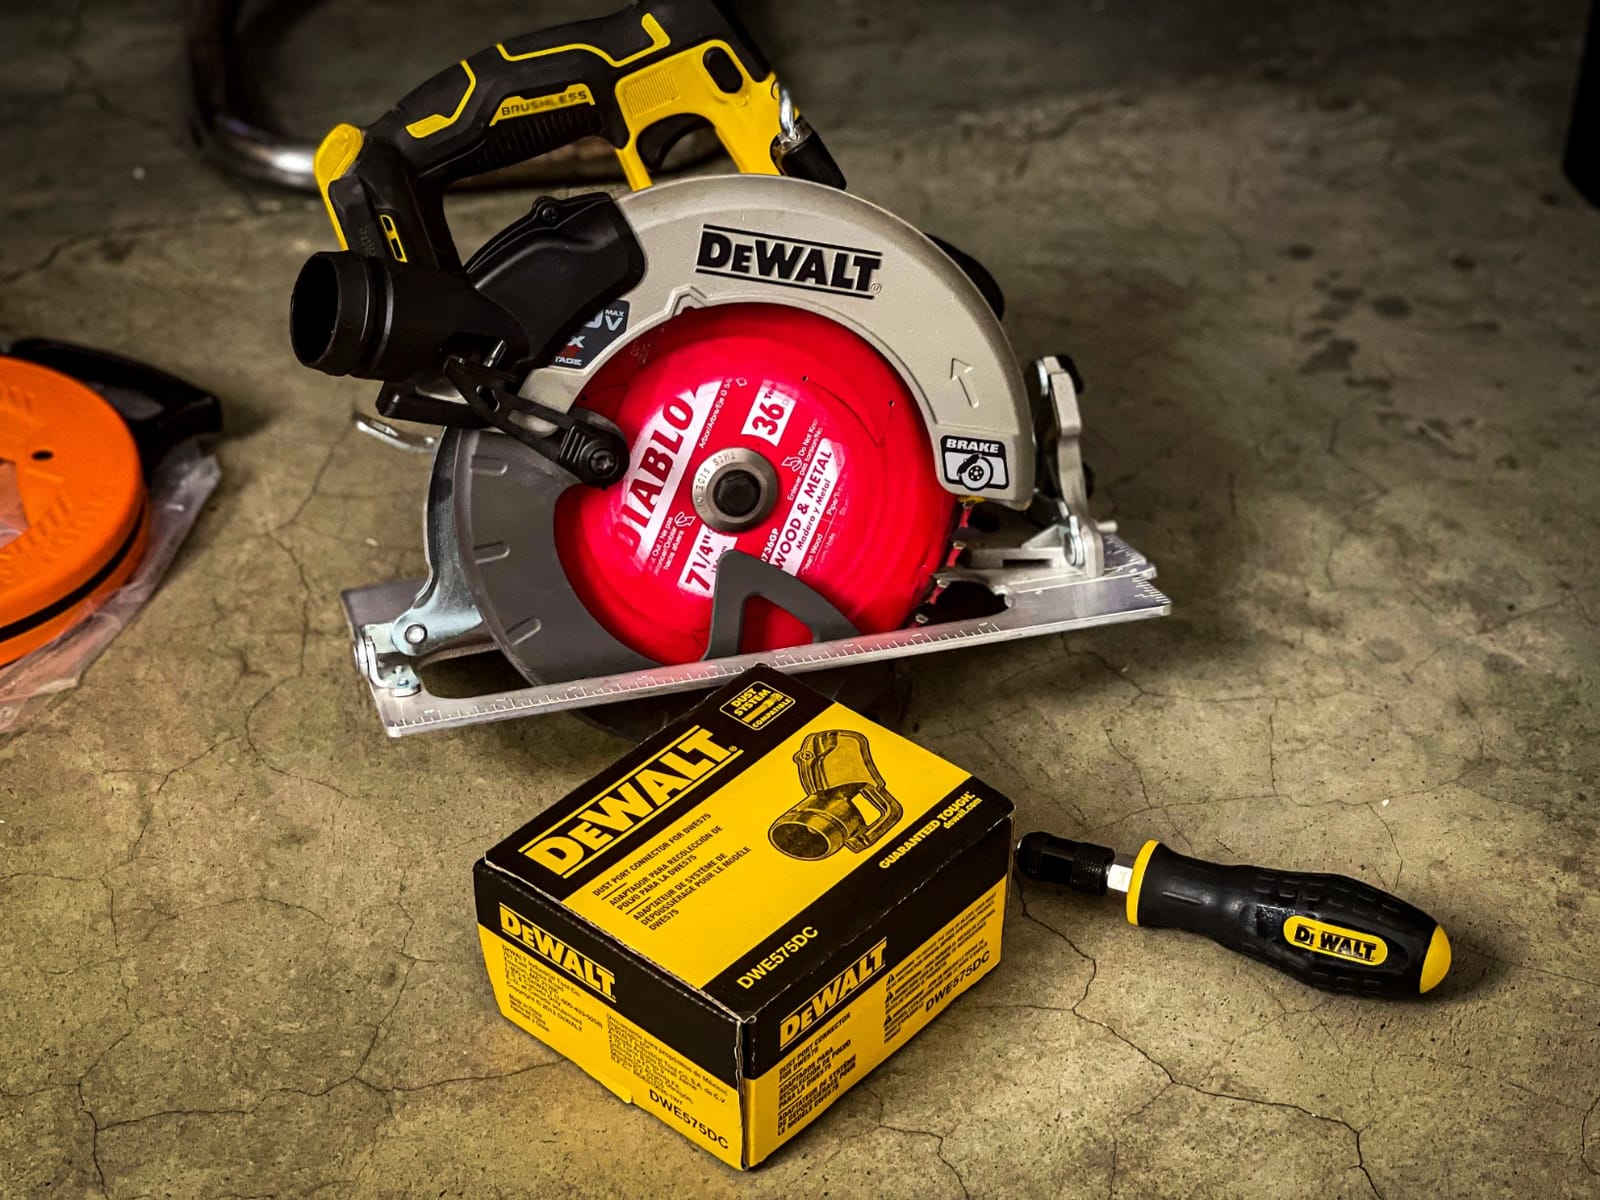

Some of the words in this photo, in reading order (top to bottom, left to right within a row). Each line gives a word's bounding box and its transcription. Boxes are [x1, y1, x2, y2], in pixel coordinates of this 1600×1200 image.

[605, 309, 624, 317] MAX
[752, 397, 785, 436] 36
[798, 446, 807, 457] Do
[803, 434, 812, 446] Not
[946, 438, 1000, 453] BRAKE
[614, 394, 695, 551] DIABLO
[771, 518, 801, 570] WOOD
[797, 502, 810, 515] &
[804, 452, 832, 499] METAL
[796, 515, 816, 551] Madera
[811, 506, 819, 514] y
[816, 479, 831, 505] Metal
[685, 568, 711, 591] 7
[731, 688, 757, 707] DUST
[734, 689, 771, 716] SYSTEM
[752, 699, 792, 728] COMPATIBLE
[592, 881, 613, 896] DUST
[611, 869, 631, 884] PORT
[629, 842, 671, 871] CONNECTOR
[668, 832, 684, 844] FOR
[682, 814, 712, 834] DWE575
[610, 877, 650, 906] ADAPTADOR
[648, 864, 670, 878] PARA
[711, 825, 723, 834] DE
[879, 820, 941, 869] GUARANTEED
[617, 894, 641, 911] POLVO
[639, 881, 660, 896] PARA
[658, 874, 670, 882] LA
[667, 855, 697, 876] DWE575
[633, 889, 676, 921] ADAPTATEUR
[674, 882, 687, 891] DE
[715, 853, 728, 862] DE
[694, 872, 715, 888] POUR
[713, 866, 725, 874] LE
[649, 909, 679, 931] DWE575
[737, 926, 818, 989] DWE575DC
[926, 950, 990, 1012] DWE575DC
[797, 1043, 813, 1061] PORT
[815, 1013, 850, 1046] CONNECTOR
[832, 1039, 851, 1059] POLVO
[779, 1062, 816, 1095] ADAPTADOR
[817, 1047, 833, 1064] PARA
[649, 1089, 728, 1149] DWE575DC
